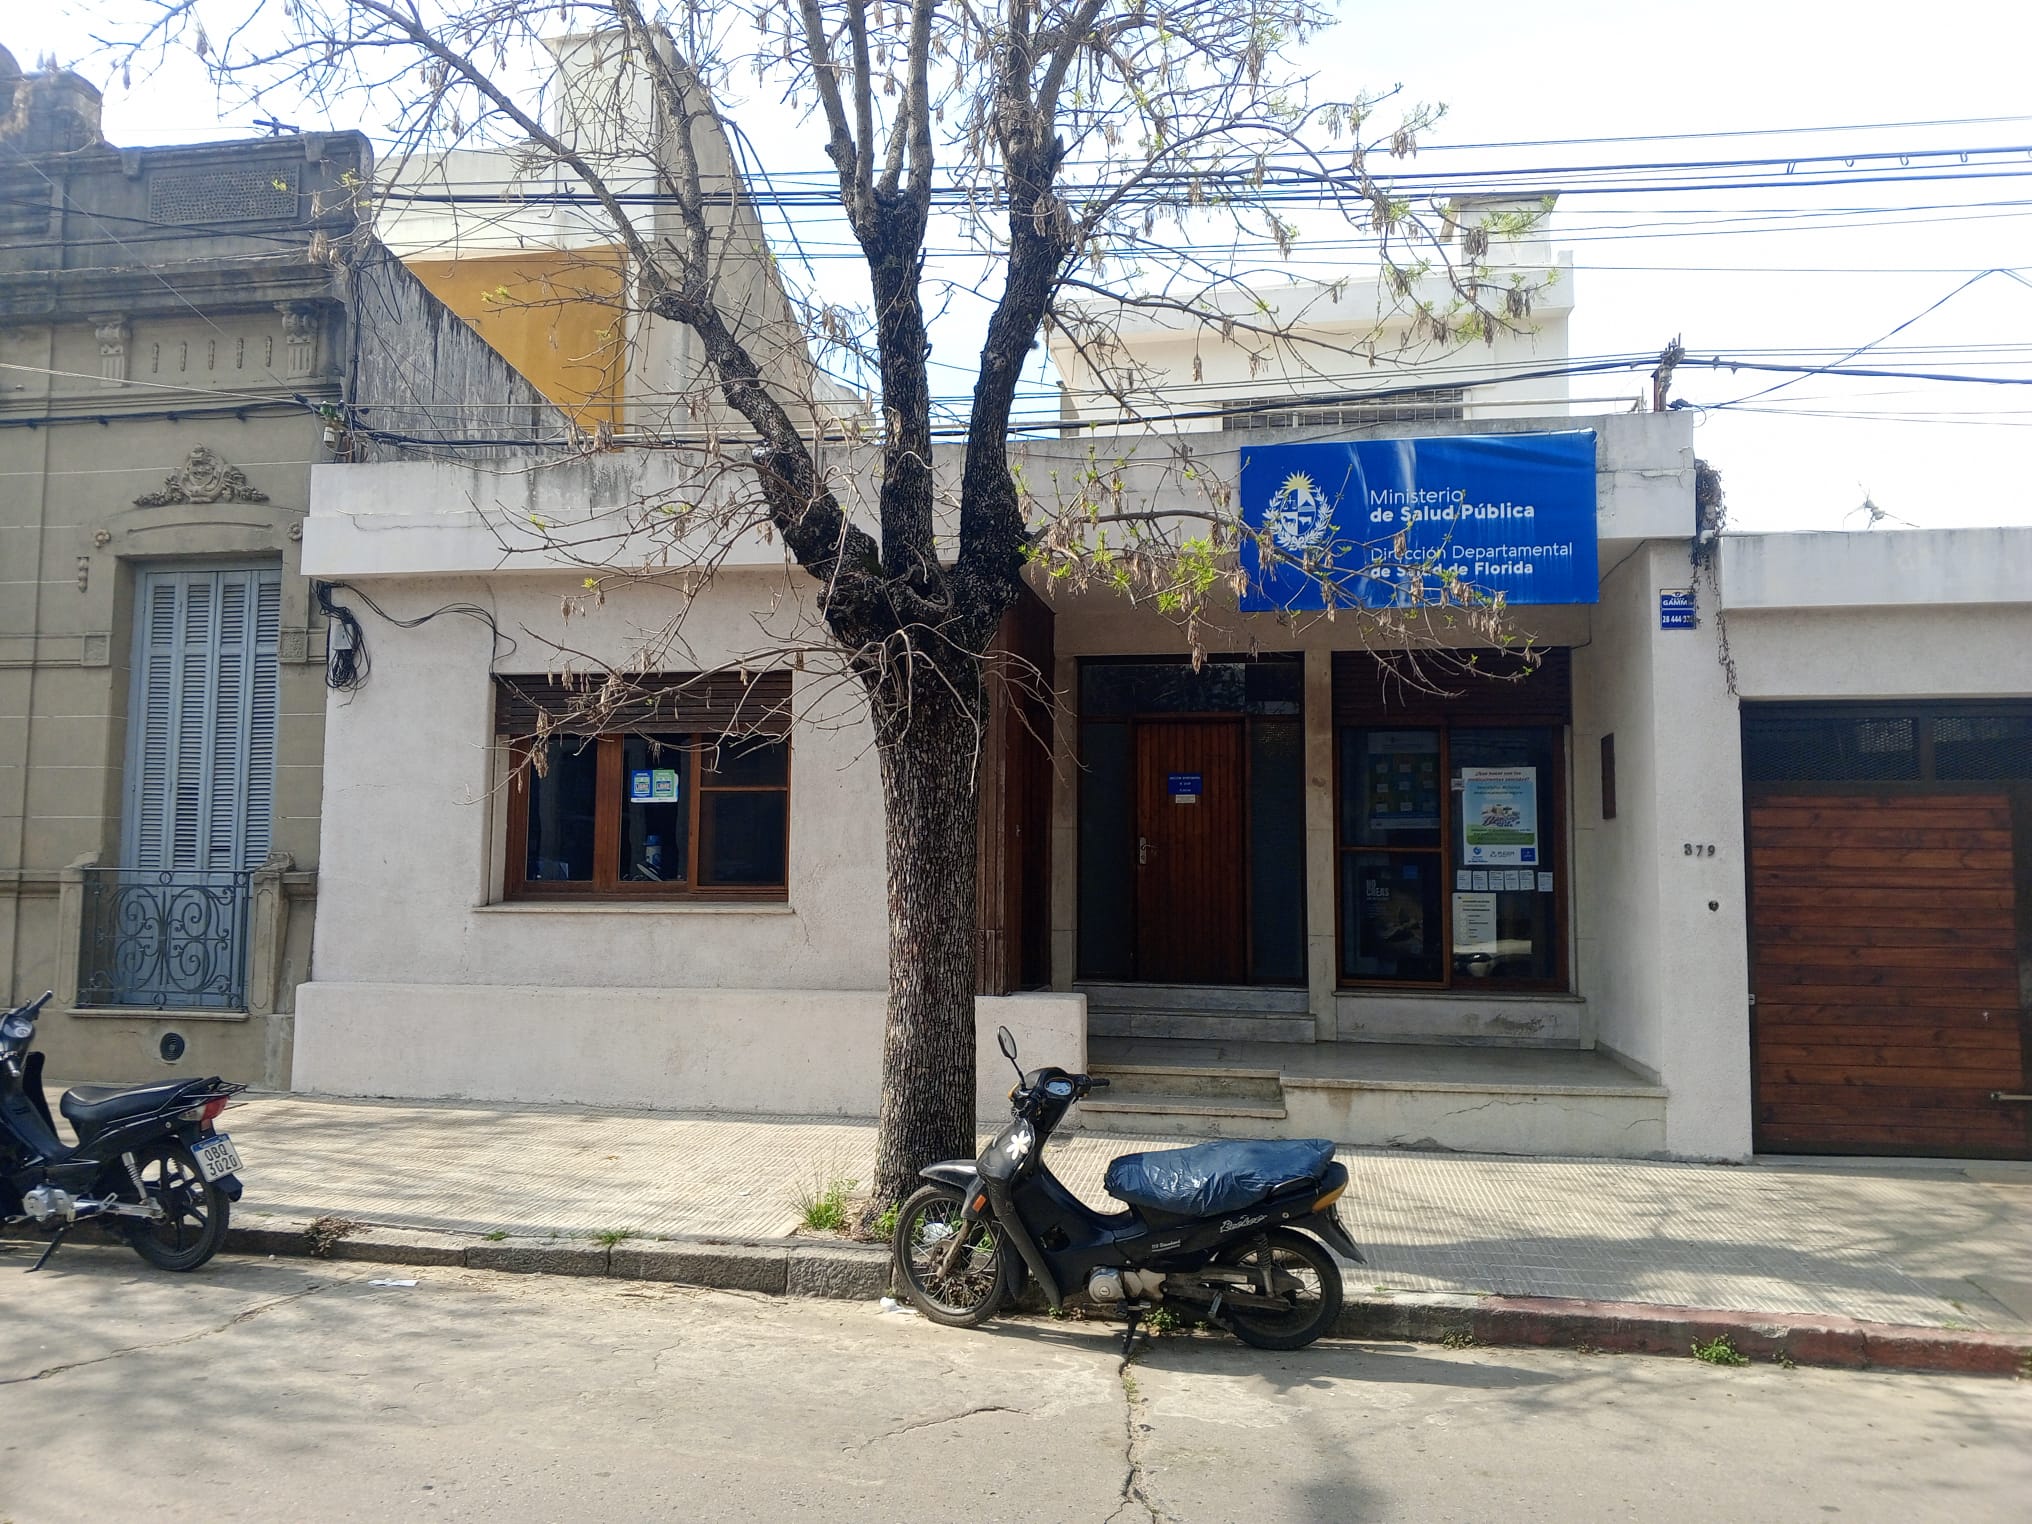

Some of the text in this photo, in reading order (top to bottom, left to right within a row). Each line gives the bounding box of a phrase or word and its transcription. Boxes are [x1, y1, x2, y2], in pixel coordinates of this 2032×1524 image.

[1370, 487, 1463, 504] Ministerio
[1370, 502, 1535, 522] de Salud Pública
[1452, 542, 1572, 561] Departamental
[1371, 565, 1391, 578] de
[1475, 560, 1533, 576] Florida
[206, 1154, 238, 1176] 3020
